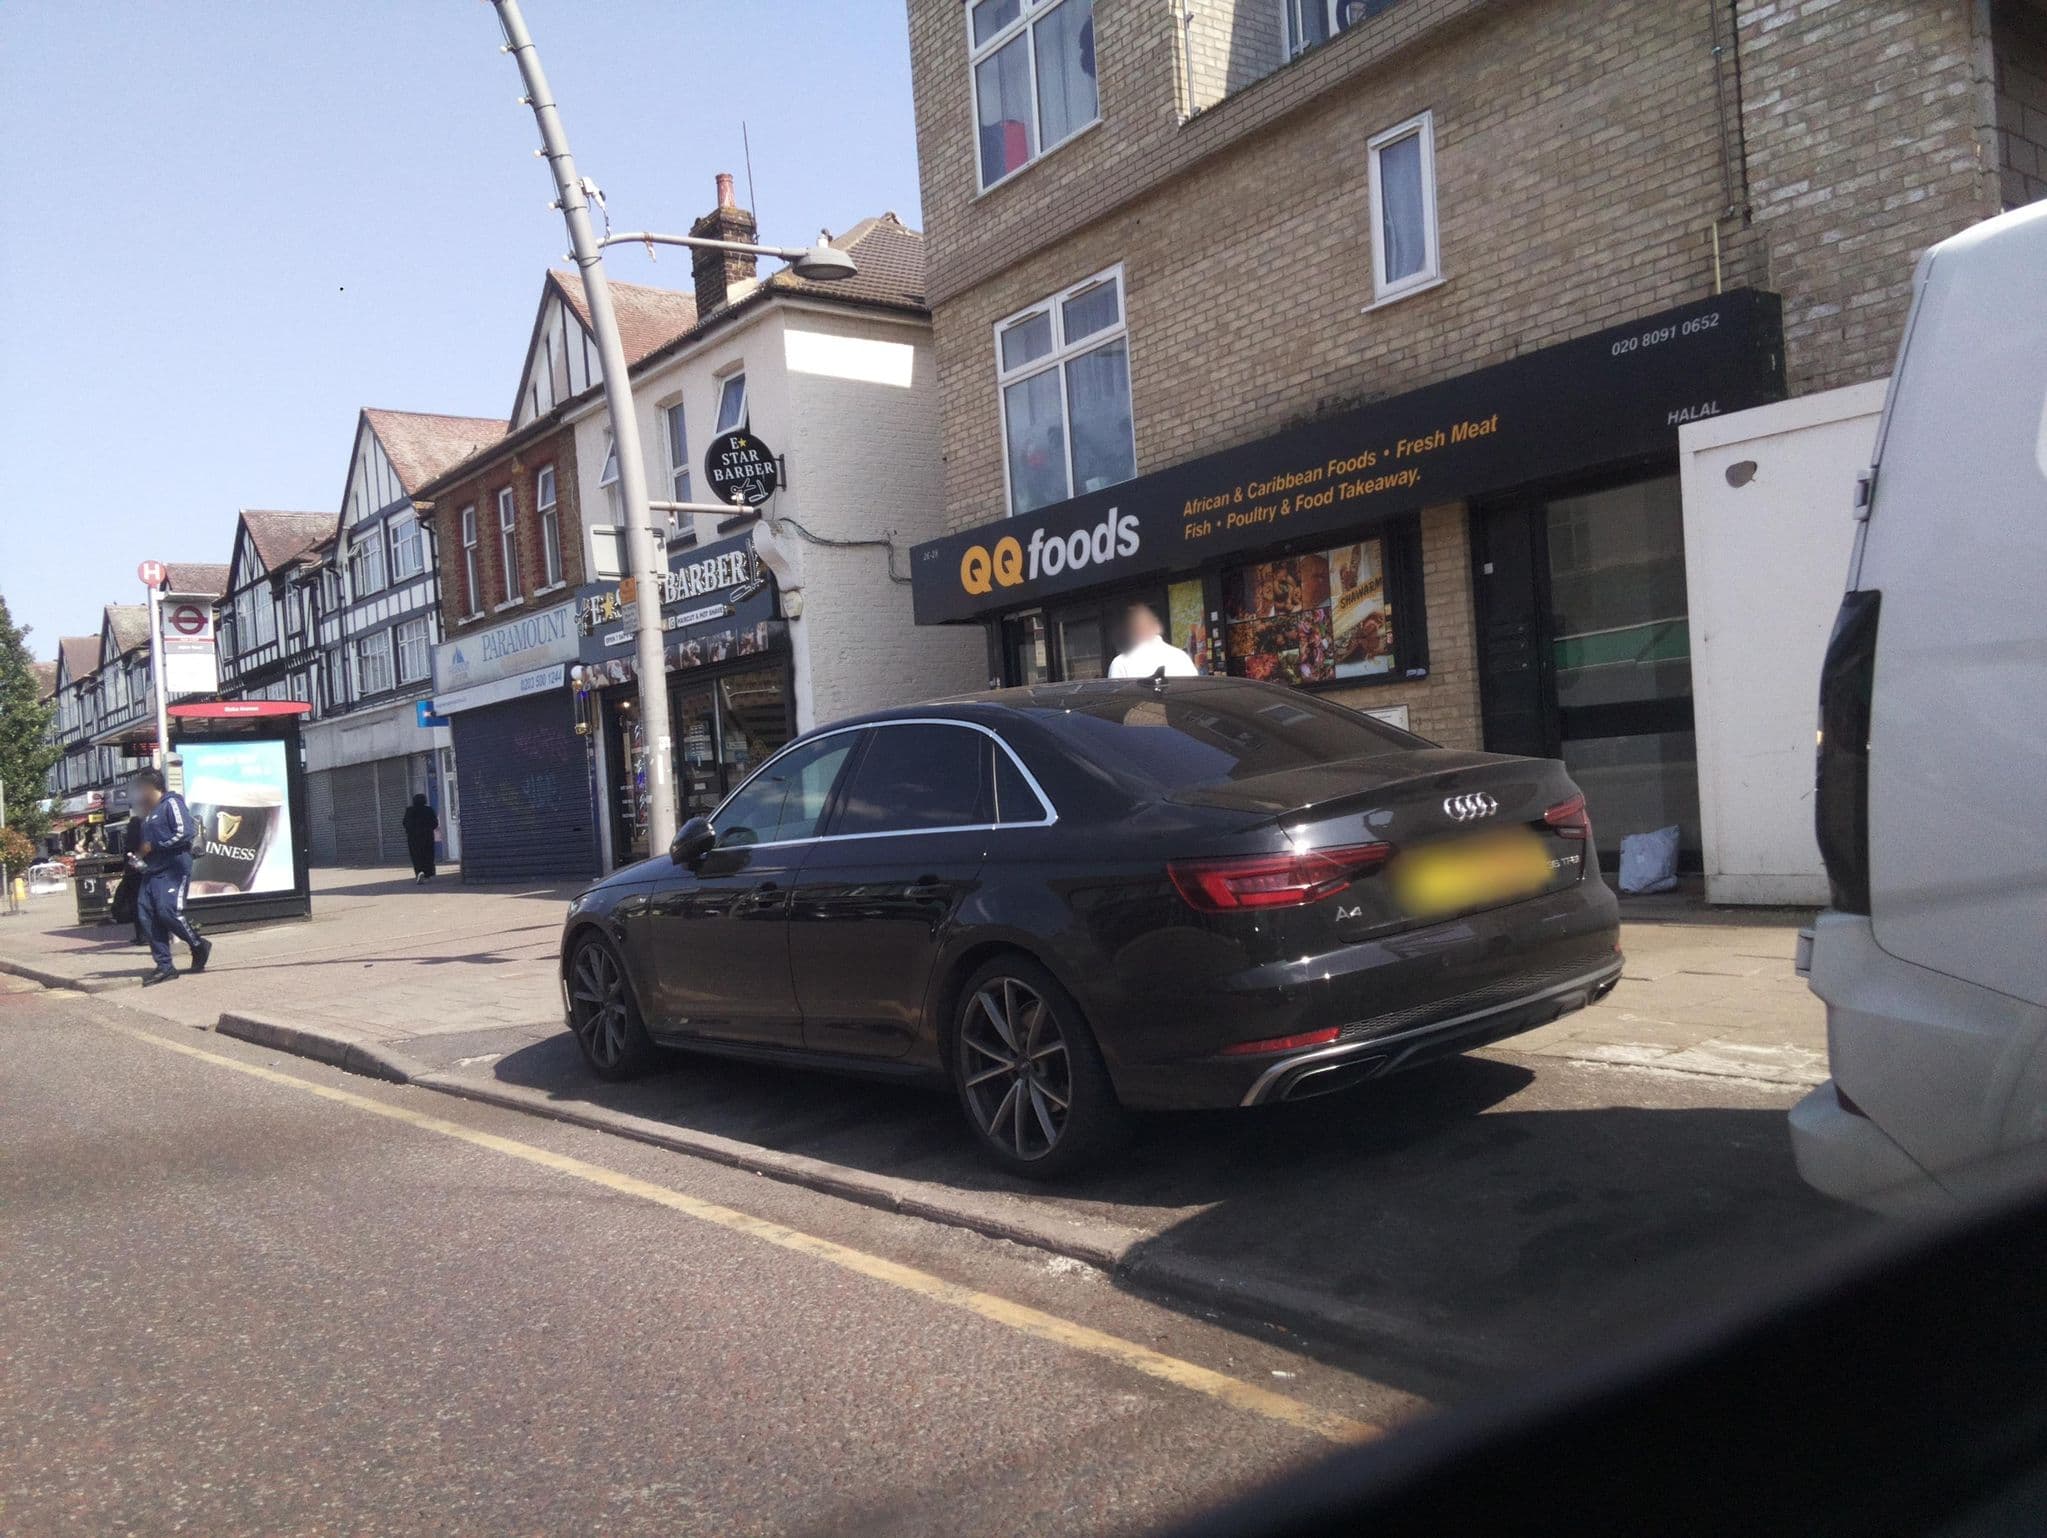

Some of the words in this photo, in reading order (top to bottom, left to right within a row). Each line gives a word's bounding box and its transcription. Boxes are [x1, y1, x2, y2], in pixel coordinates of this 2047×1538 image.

[1611, 337, 1638, 356] 020
[1641, 325, 1677, 347] 8091
[1681, 312, 1720, 336] 0652
[1667, 400, 1721, 425] HALAL
[713, 462, 775, 482] BARBER
[721, 449, 760, 466] STAR
[1183, 493, 1230, 517] African
[1233, 486, 1244, 503] &
[1247, 467, 1323, 499] Caribbean
[1327, 450, 1377, 478] Foods
[1396, 429, 1445, 458] Fresh
[1451, 413, 1498, 443] Meat
[1184, 520, 1212, 540] Fish
[1226, 504, 1277, 529] Poultry
[1280, 498, 1291, 515] &
[1295, 486, 1334, 512] Food
[1338, 467, 1421, 501] Takeaway.
[143, 563, 161, 580] H
[665, 550, 747, 604] BARBER
[1339, 576, 1384, 610] SHAWARM
[481, 608, 568, 662] PARAMOUNT
[205, 841, 256, 861] INNESS
[1335, 906, 1362, 922] A4
